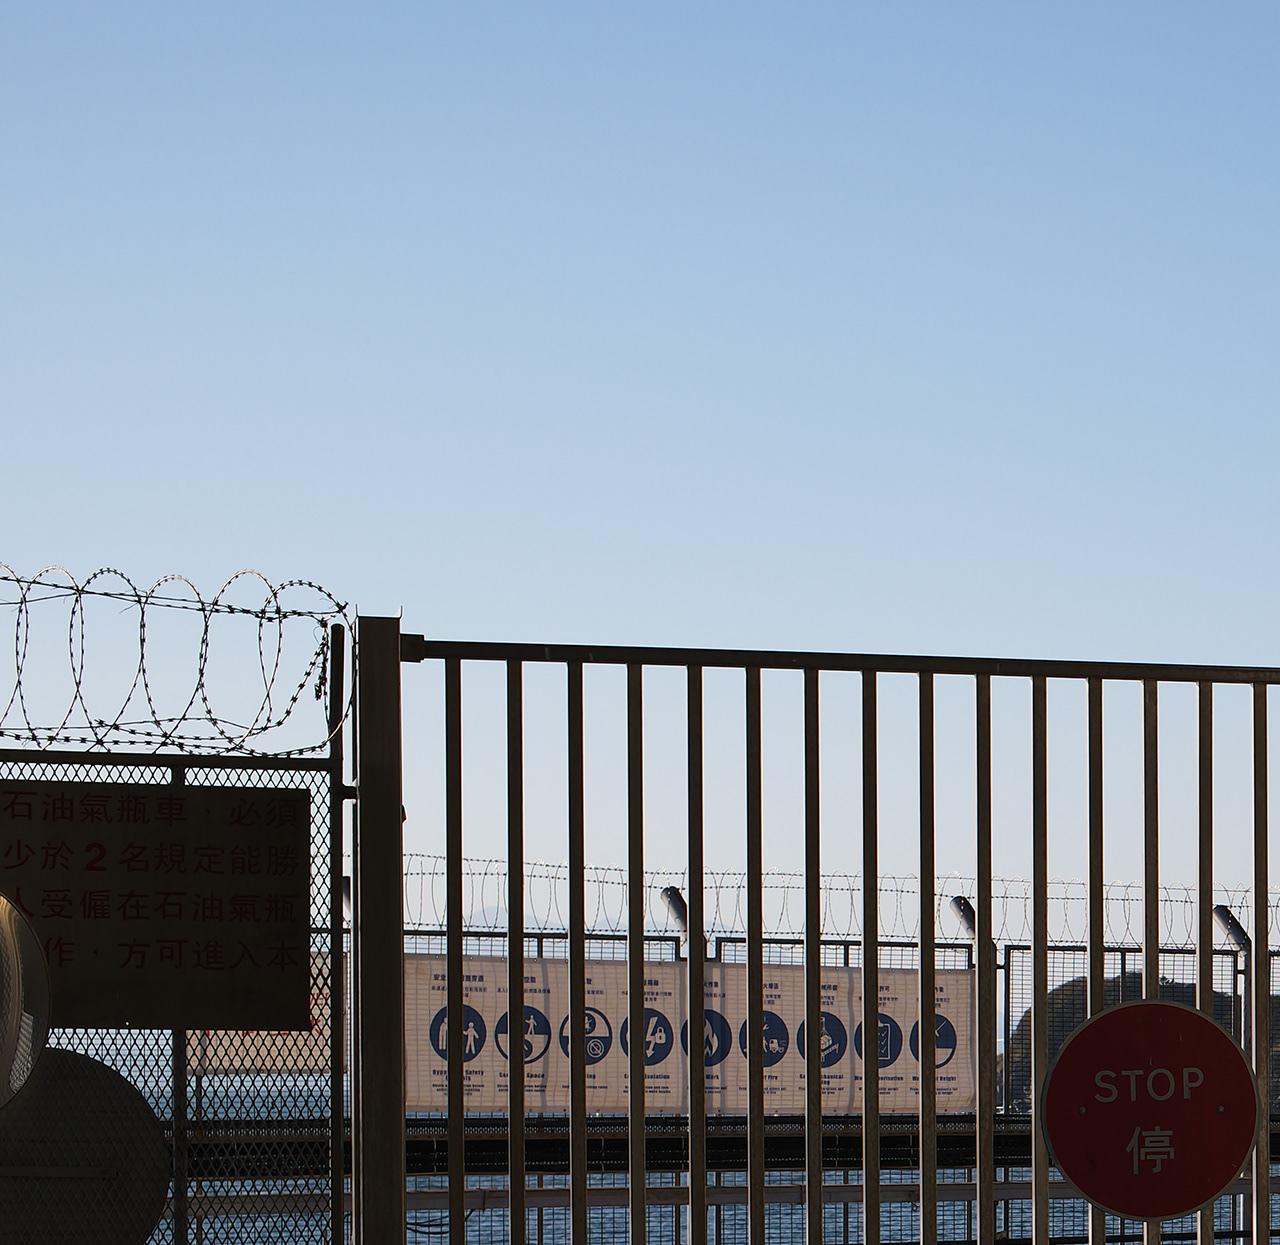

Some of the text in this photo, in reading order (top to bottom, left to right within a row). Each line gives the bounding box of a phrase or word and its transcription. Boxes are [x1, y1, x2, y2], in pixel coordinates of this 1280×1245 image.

[526, 1072, 545, 1080] Space
[1094, 1067, 1205, 1103] STOP
[1125, 1125, 1175, 1175] 停
